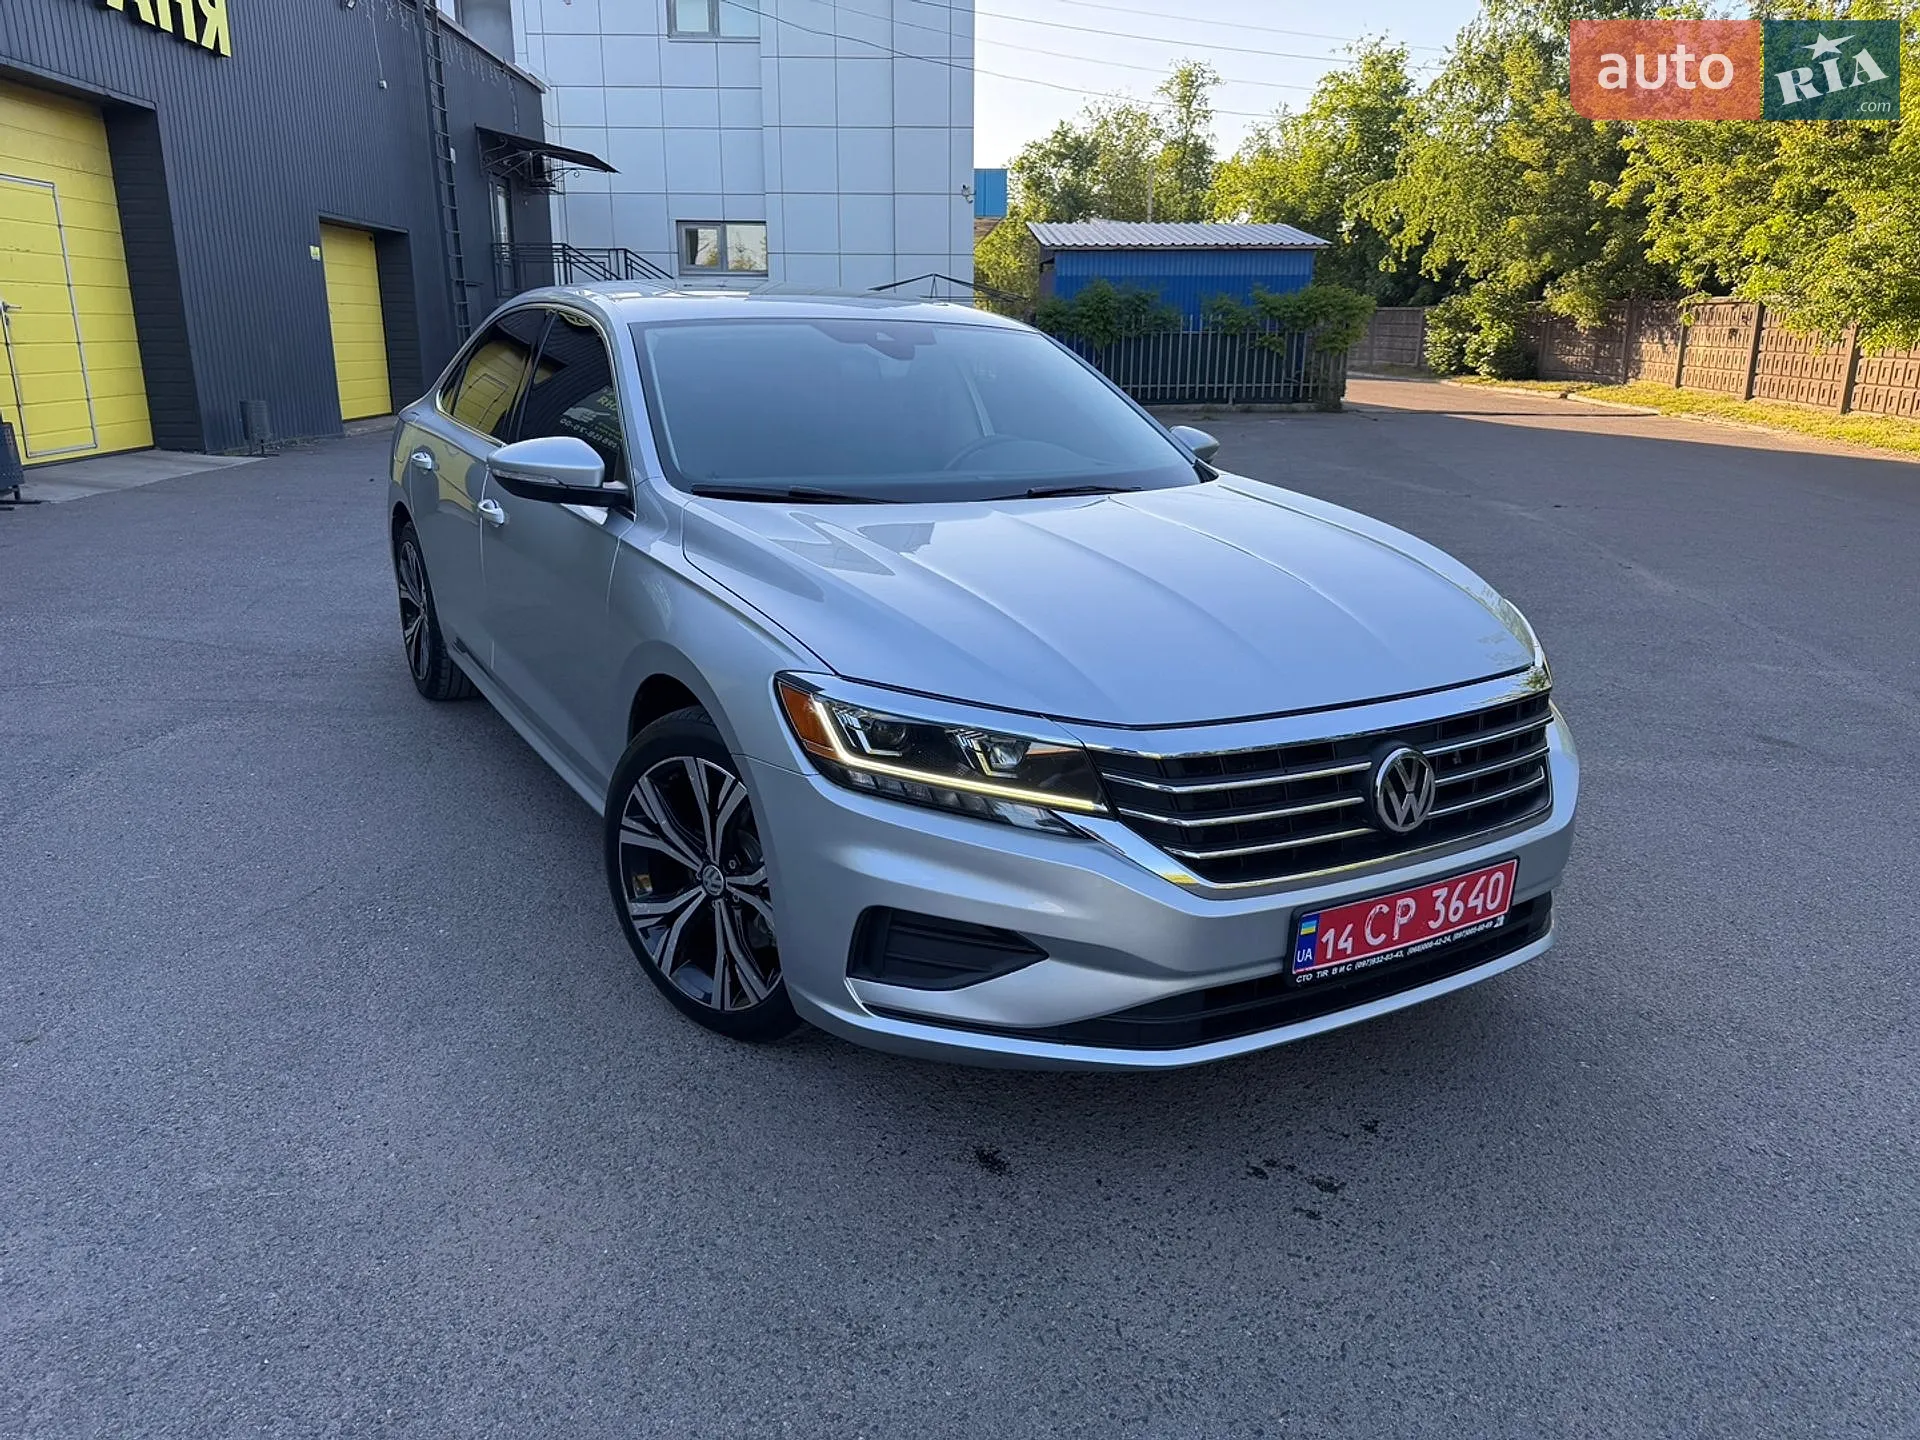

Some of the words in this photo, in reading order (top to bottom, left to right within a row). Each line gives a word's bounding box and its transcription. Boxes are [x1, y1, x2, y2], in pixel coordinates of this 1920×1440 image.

[1321, 923, 1354, 960] 14
[1427, 871, 1505, 929] 3640
[1296, 948, 1313, 963] UA
